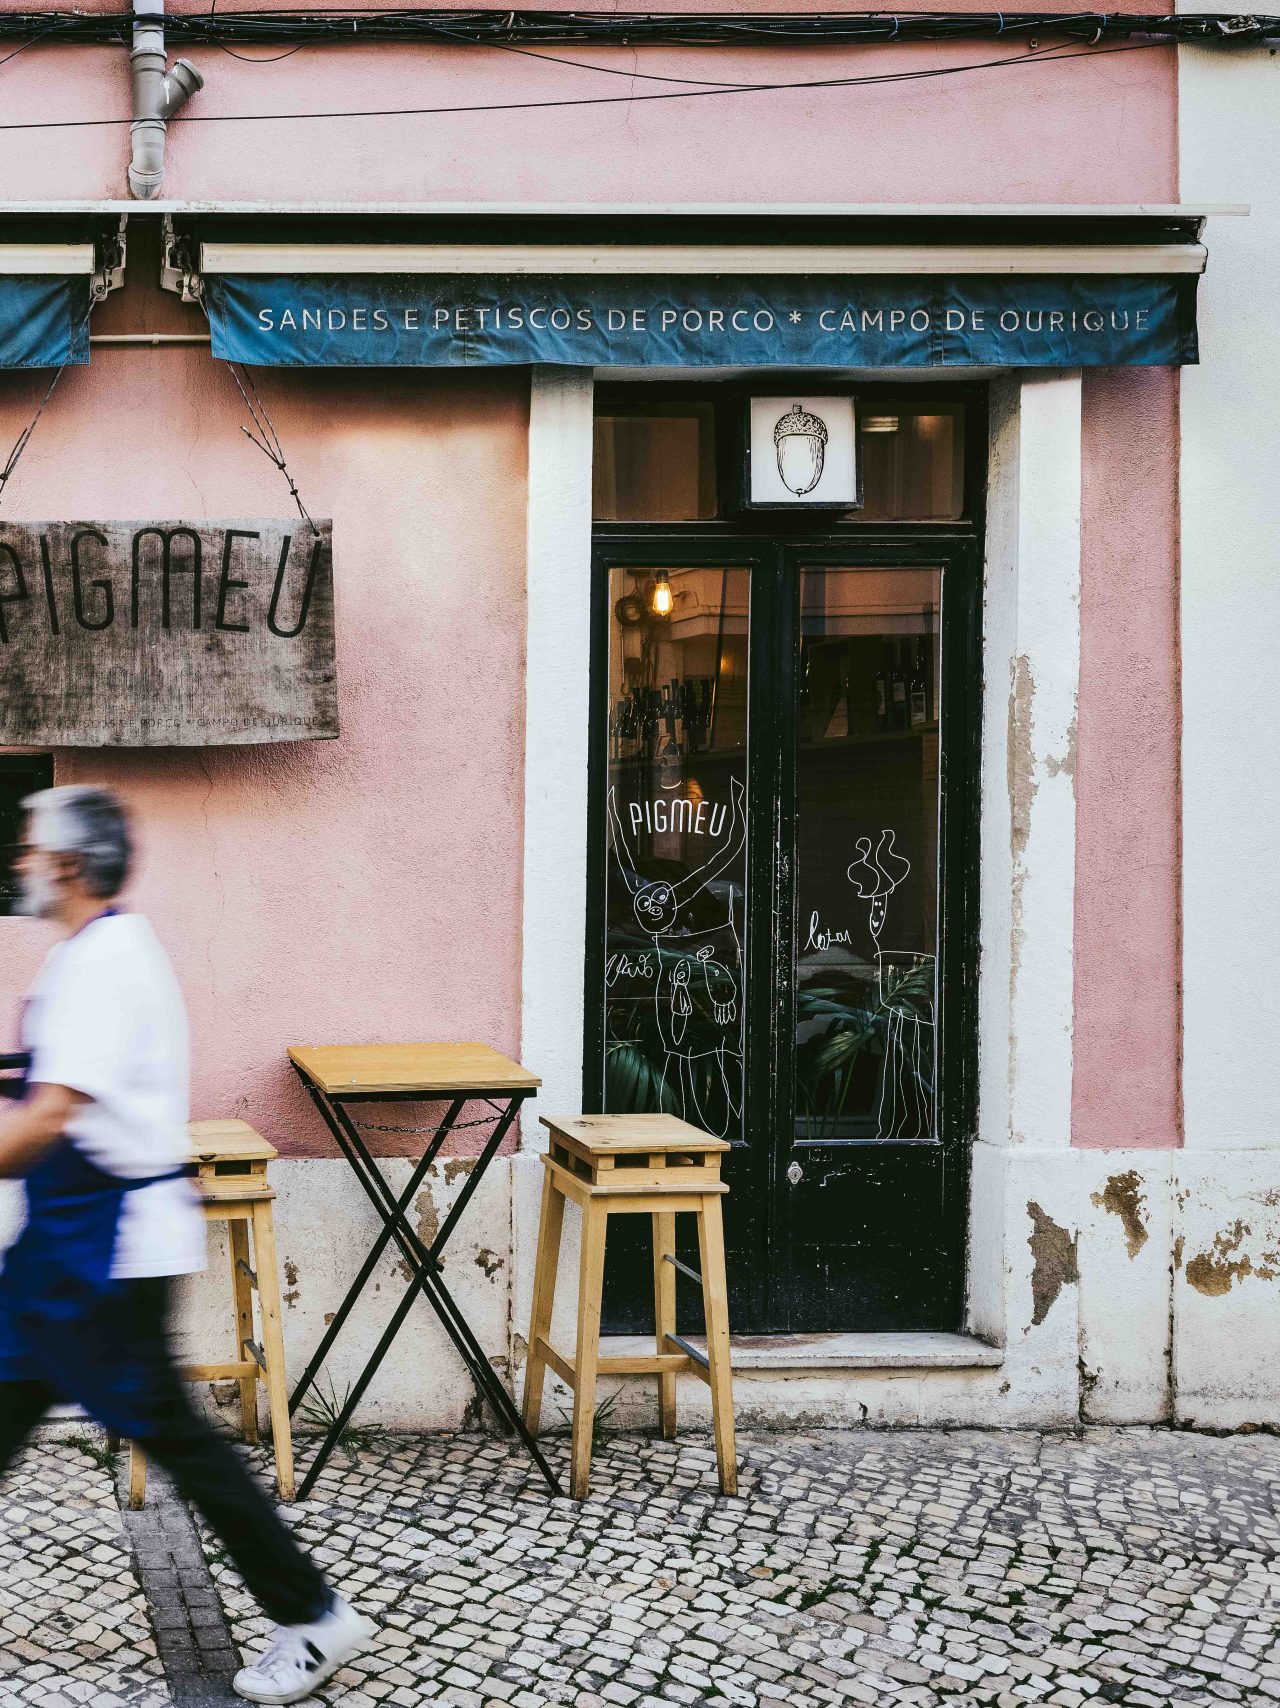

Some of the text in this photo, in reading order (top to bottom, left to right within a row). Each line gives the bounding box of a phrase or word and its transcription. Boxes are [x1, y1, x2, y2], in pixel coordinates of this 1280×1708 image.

[258, 307, 1150, 333] SANDES E PETISCOS DE PORCO CAMPO DE OURIQUE
[262, 717, 320, 727] OURIQUE
[629, 799, 727, 837] PIGMEU
